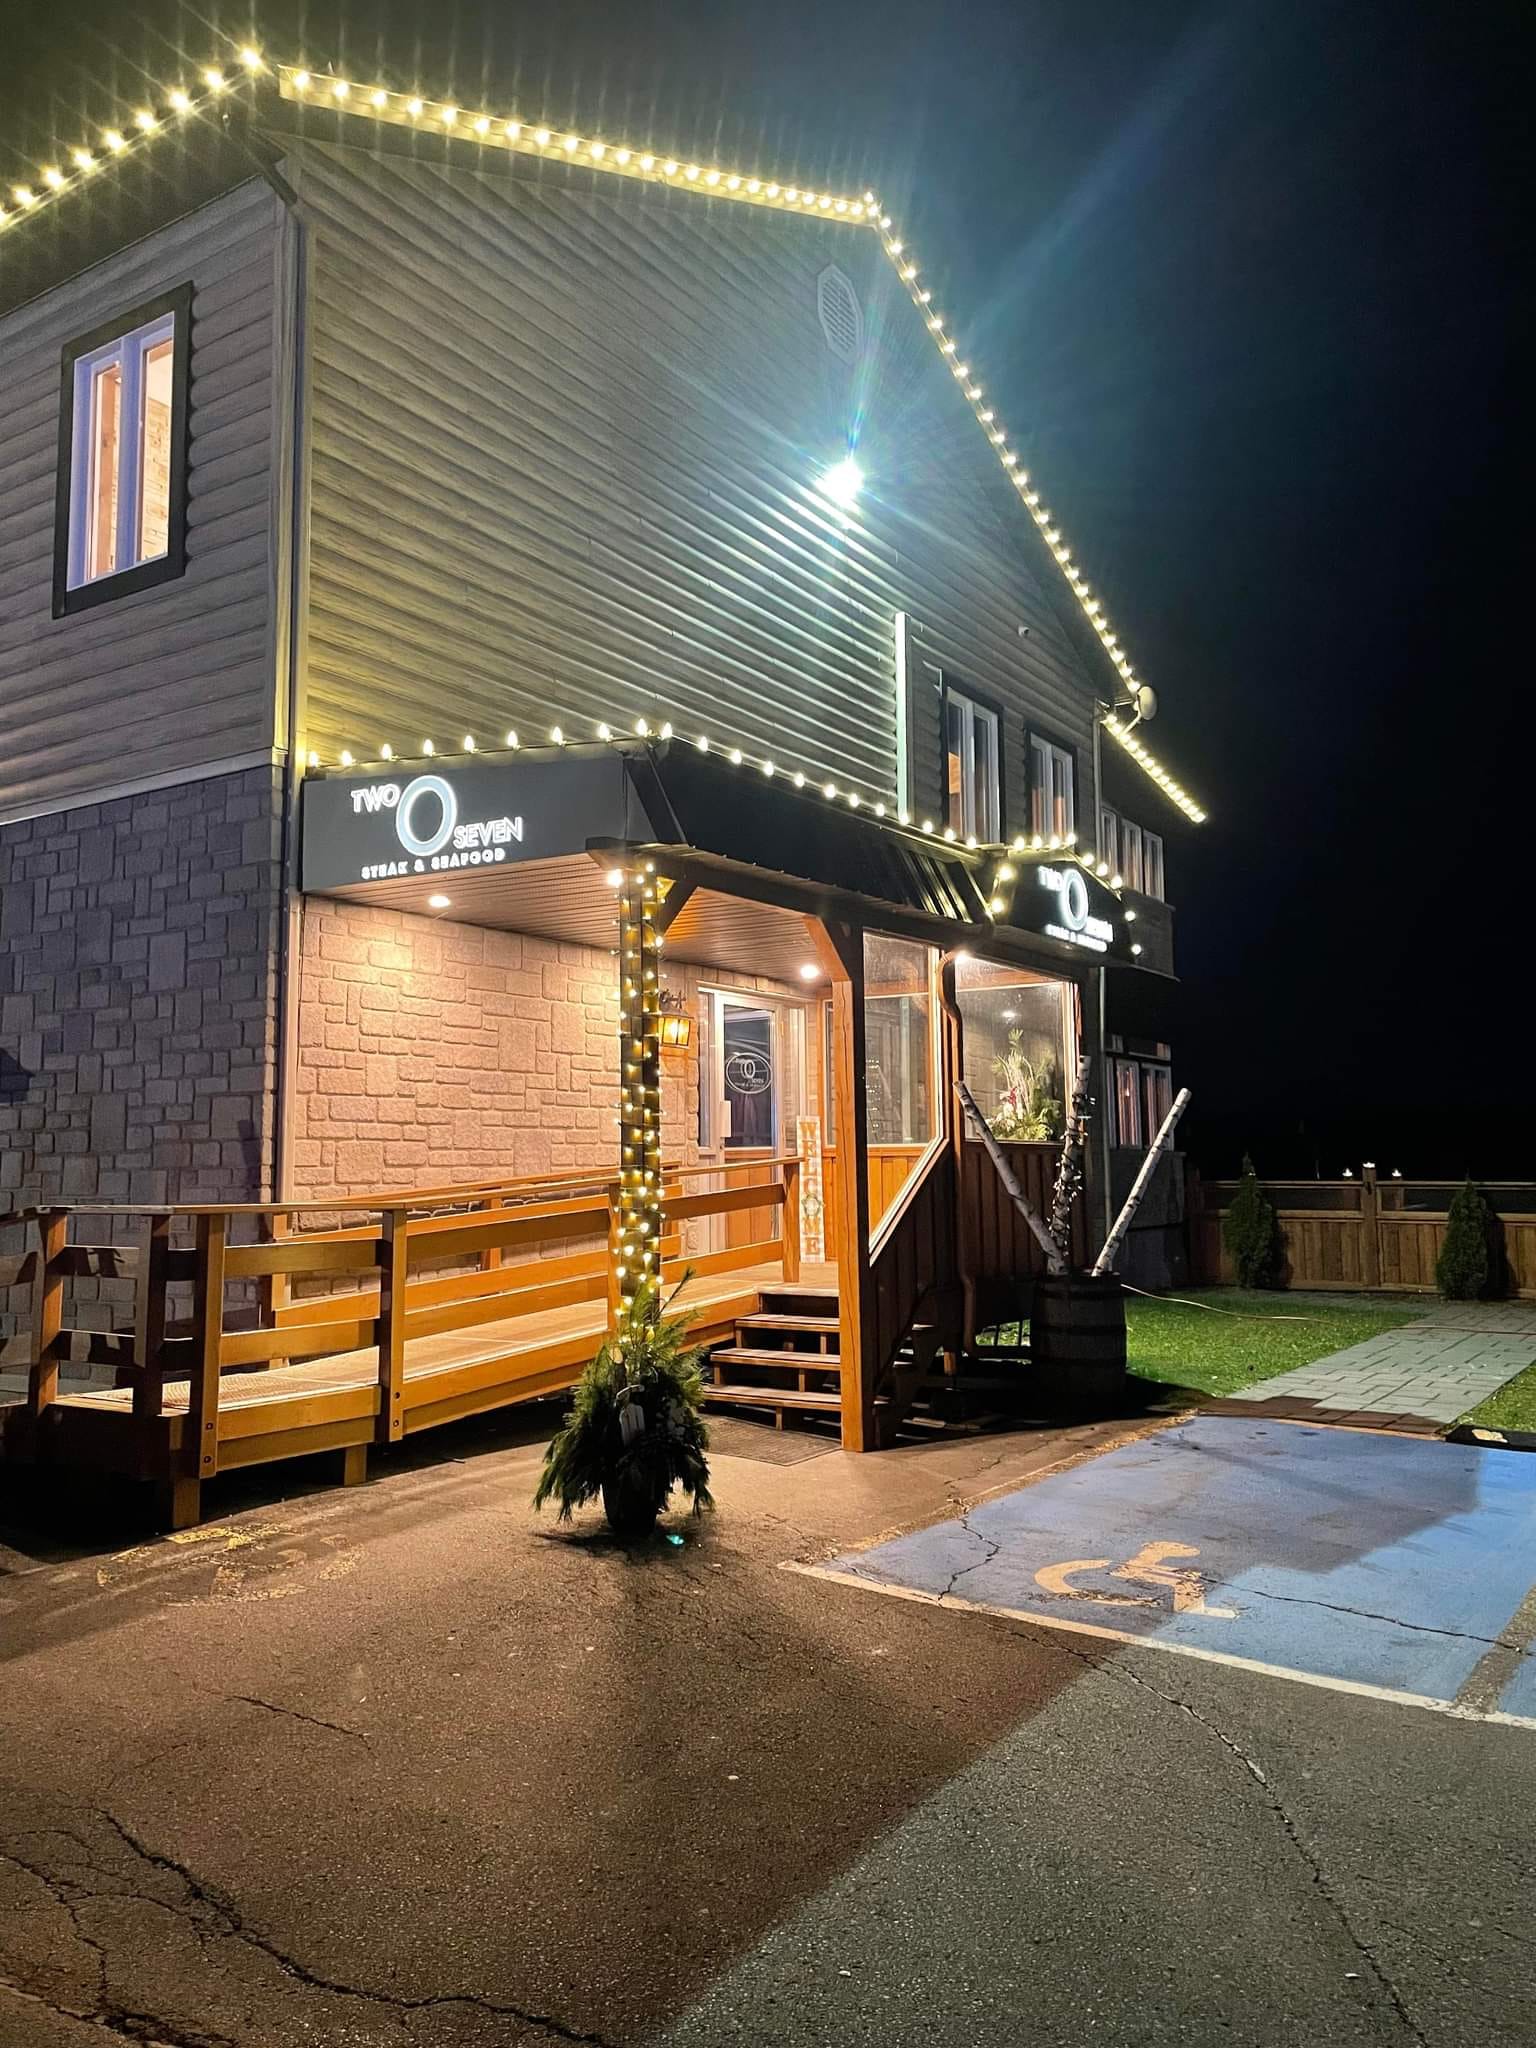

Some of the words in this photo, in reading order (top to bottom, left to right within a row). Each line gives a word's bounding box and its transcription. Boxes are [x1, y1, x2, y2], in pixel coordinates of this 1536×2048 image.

[351, 784, 399, 812] TWO
[396, 775, 457, 856] O
[454, 817, 523, 848] SEVEN
[361, 860, 407, 879] STEAK
[414, 859, 426, 873] &
[431, 848, 505, 870] SEAFOOD
